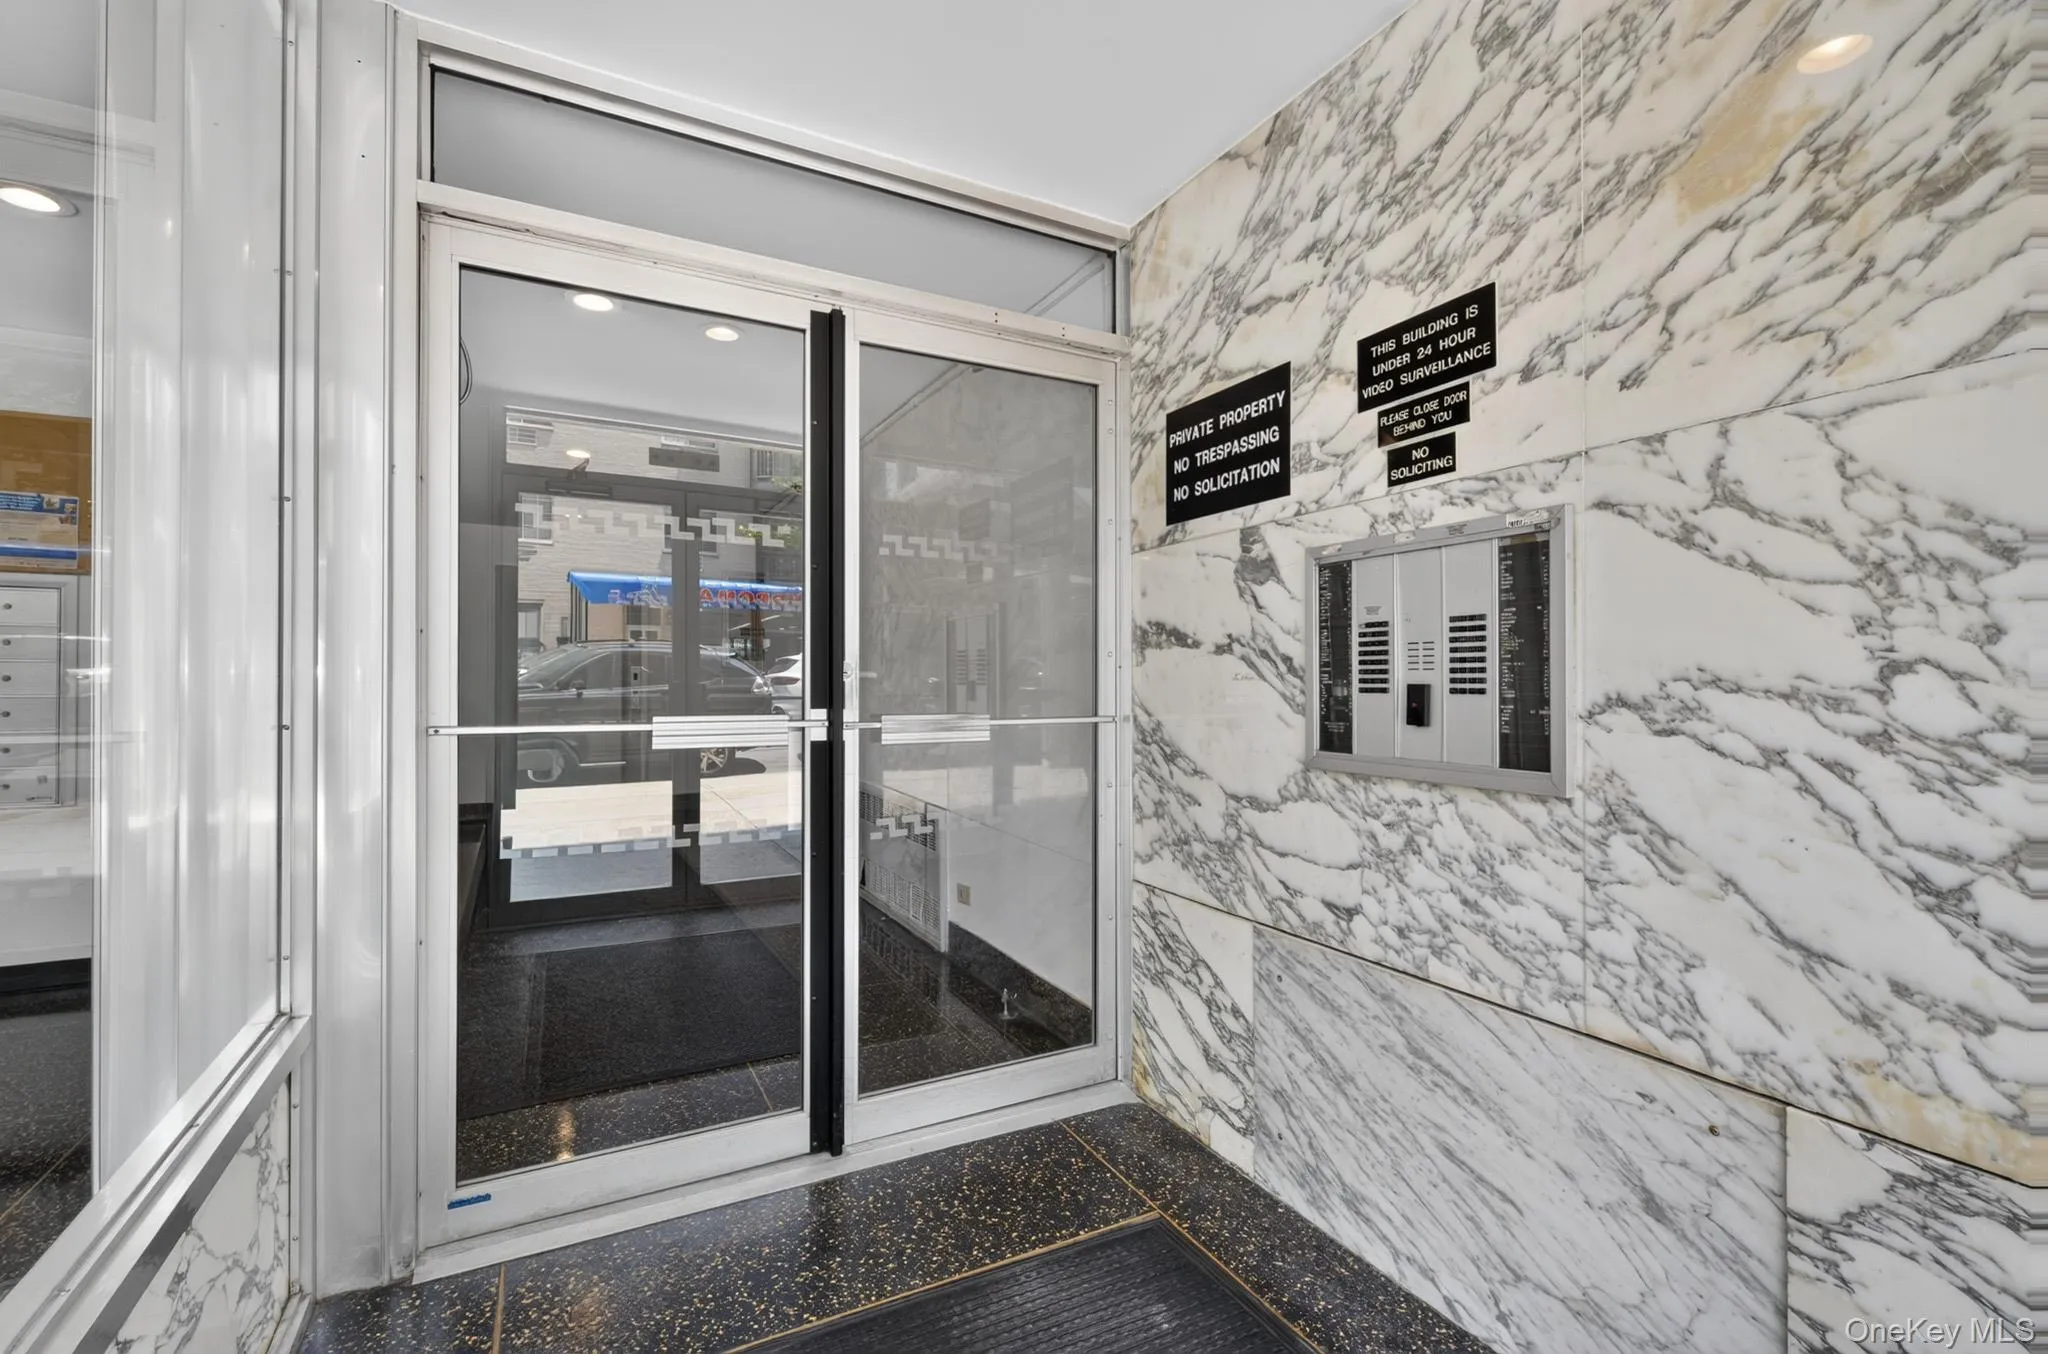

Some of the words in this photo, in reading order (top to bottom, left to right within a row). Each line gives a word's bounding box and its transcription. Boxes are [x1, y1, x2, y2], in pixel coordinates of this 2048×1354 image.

[1370, 339, 1396, 358] THIS
[1402, 313, 1459, 345] BUILDING
[1465, 304, 1478, 319] IS
[1372, 352, 1411, 376] UNDER
[1417, 344, 1432, 359] 24
[1439, 327, 1476, 350] HOUR
[1362, 379, 1394, 399] VIDEO
[1400, 341, 1491, 385] SURVEILLANCE
[1169, 418, 1214, 448] PRIVATE
[1220, 390, 1285, 430] PROPERTY
[1380, 409, 1409, 427] PLEASE
[1413, 399, 1440, 416] CLOSE
[1443, 390, 1467, 407] DOOR
[1393, 418, 1426, 436] BEHIND
[1431, 410, 1452, 424] YOU
[1173, 457, 1190, 474] NO
[1195, 425, 1280, 467] TRESPASSING
[1390, 455, 1453, 480] SOLICITING
[1411, 446, 1429, 460] NO
[1173, 485, 1190, 502] NO
[1194, 457, 1280, 496] SOLICITATION
